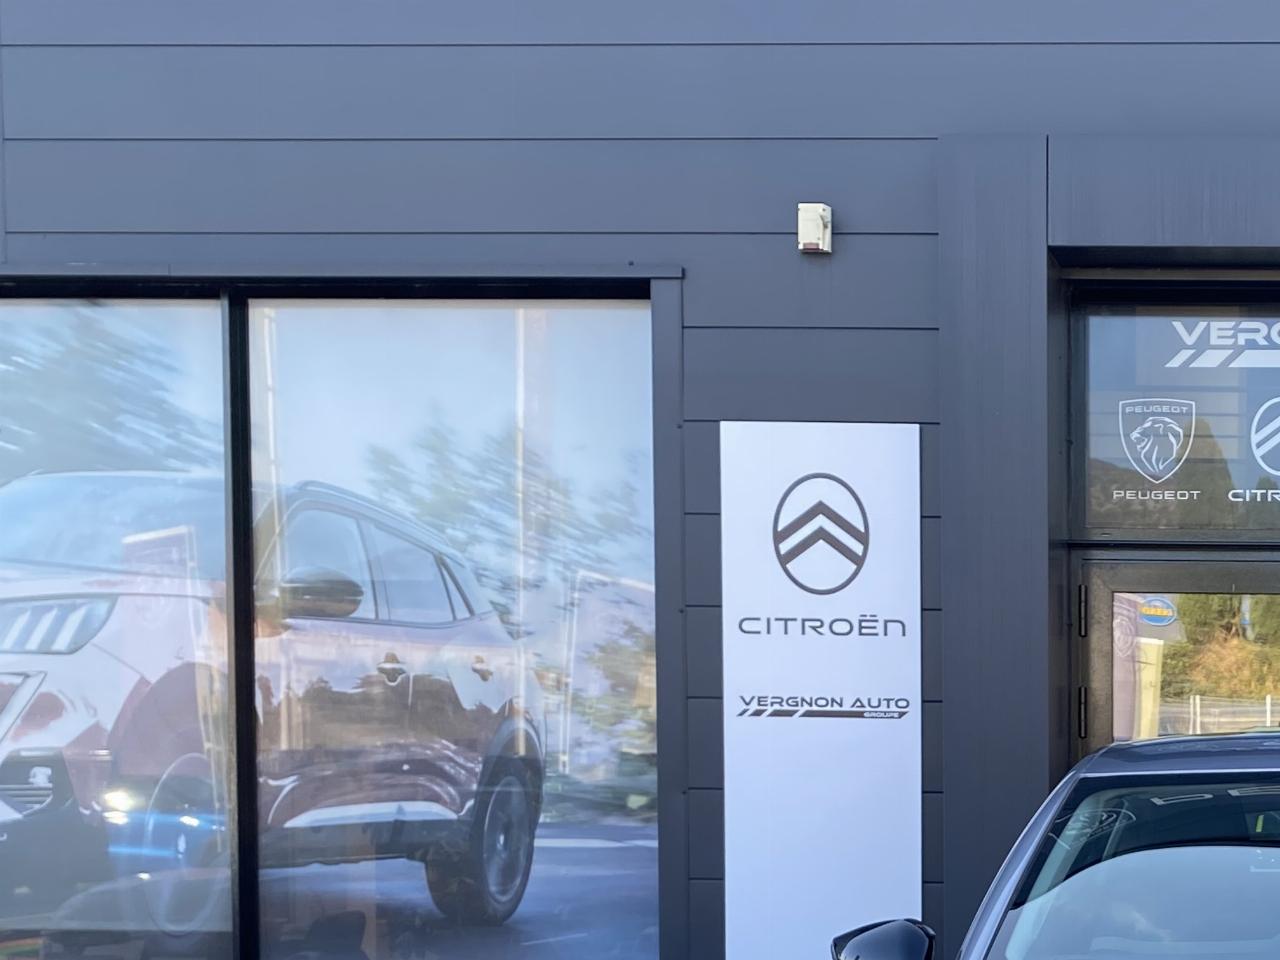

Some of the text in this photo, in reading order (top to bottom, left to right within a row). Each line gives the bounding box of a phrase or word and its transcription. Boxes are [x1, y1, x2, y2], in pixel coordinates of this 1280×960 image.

[1125, 404, 1188, 414] PEUGEOT
[1112, 490, 1200, 500] PEUGEOT
[738, 614, 906, 637] CITROËN
[739, 695, 910, 709] VERGNON AUTO
